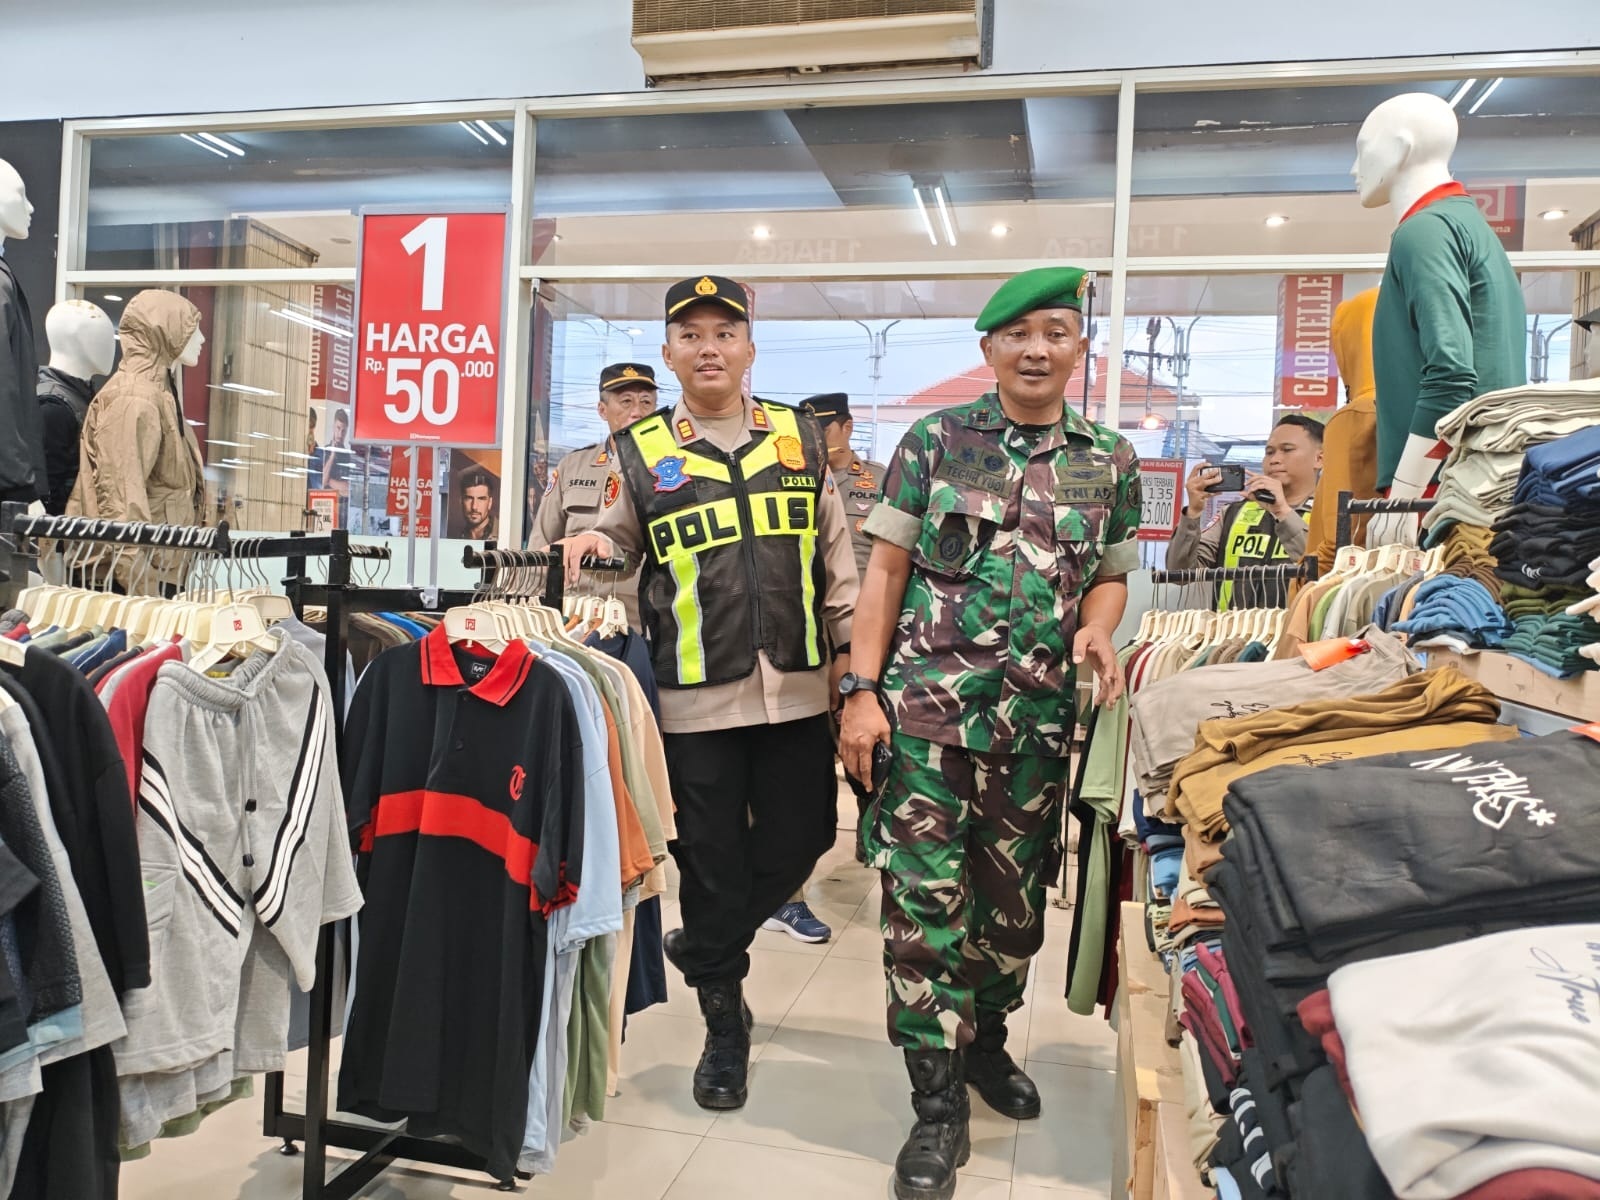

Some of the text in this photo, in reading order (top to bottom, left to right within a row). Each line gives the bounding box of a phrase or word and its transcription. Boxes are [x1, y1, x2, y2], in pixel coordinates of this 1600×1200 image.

[400, 217, 448, 311] 1
[366, 323, 495, 354] HARGA
[1293, 276, 1332, 396] GABRIELLE
[365, 357, 385, 374] Rp.
[568, 479, 597, 487] SEKEN
[783, 477, 815, 486] POLRI
[1094, 487, 1111, 500] AD
[1148, 488, 1173, 500] 135
